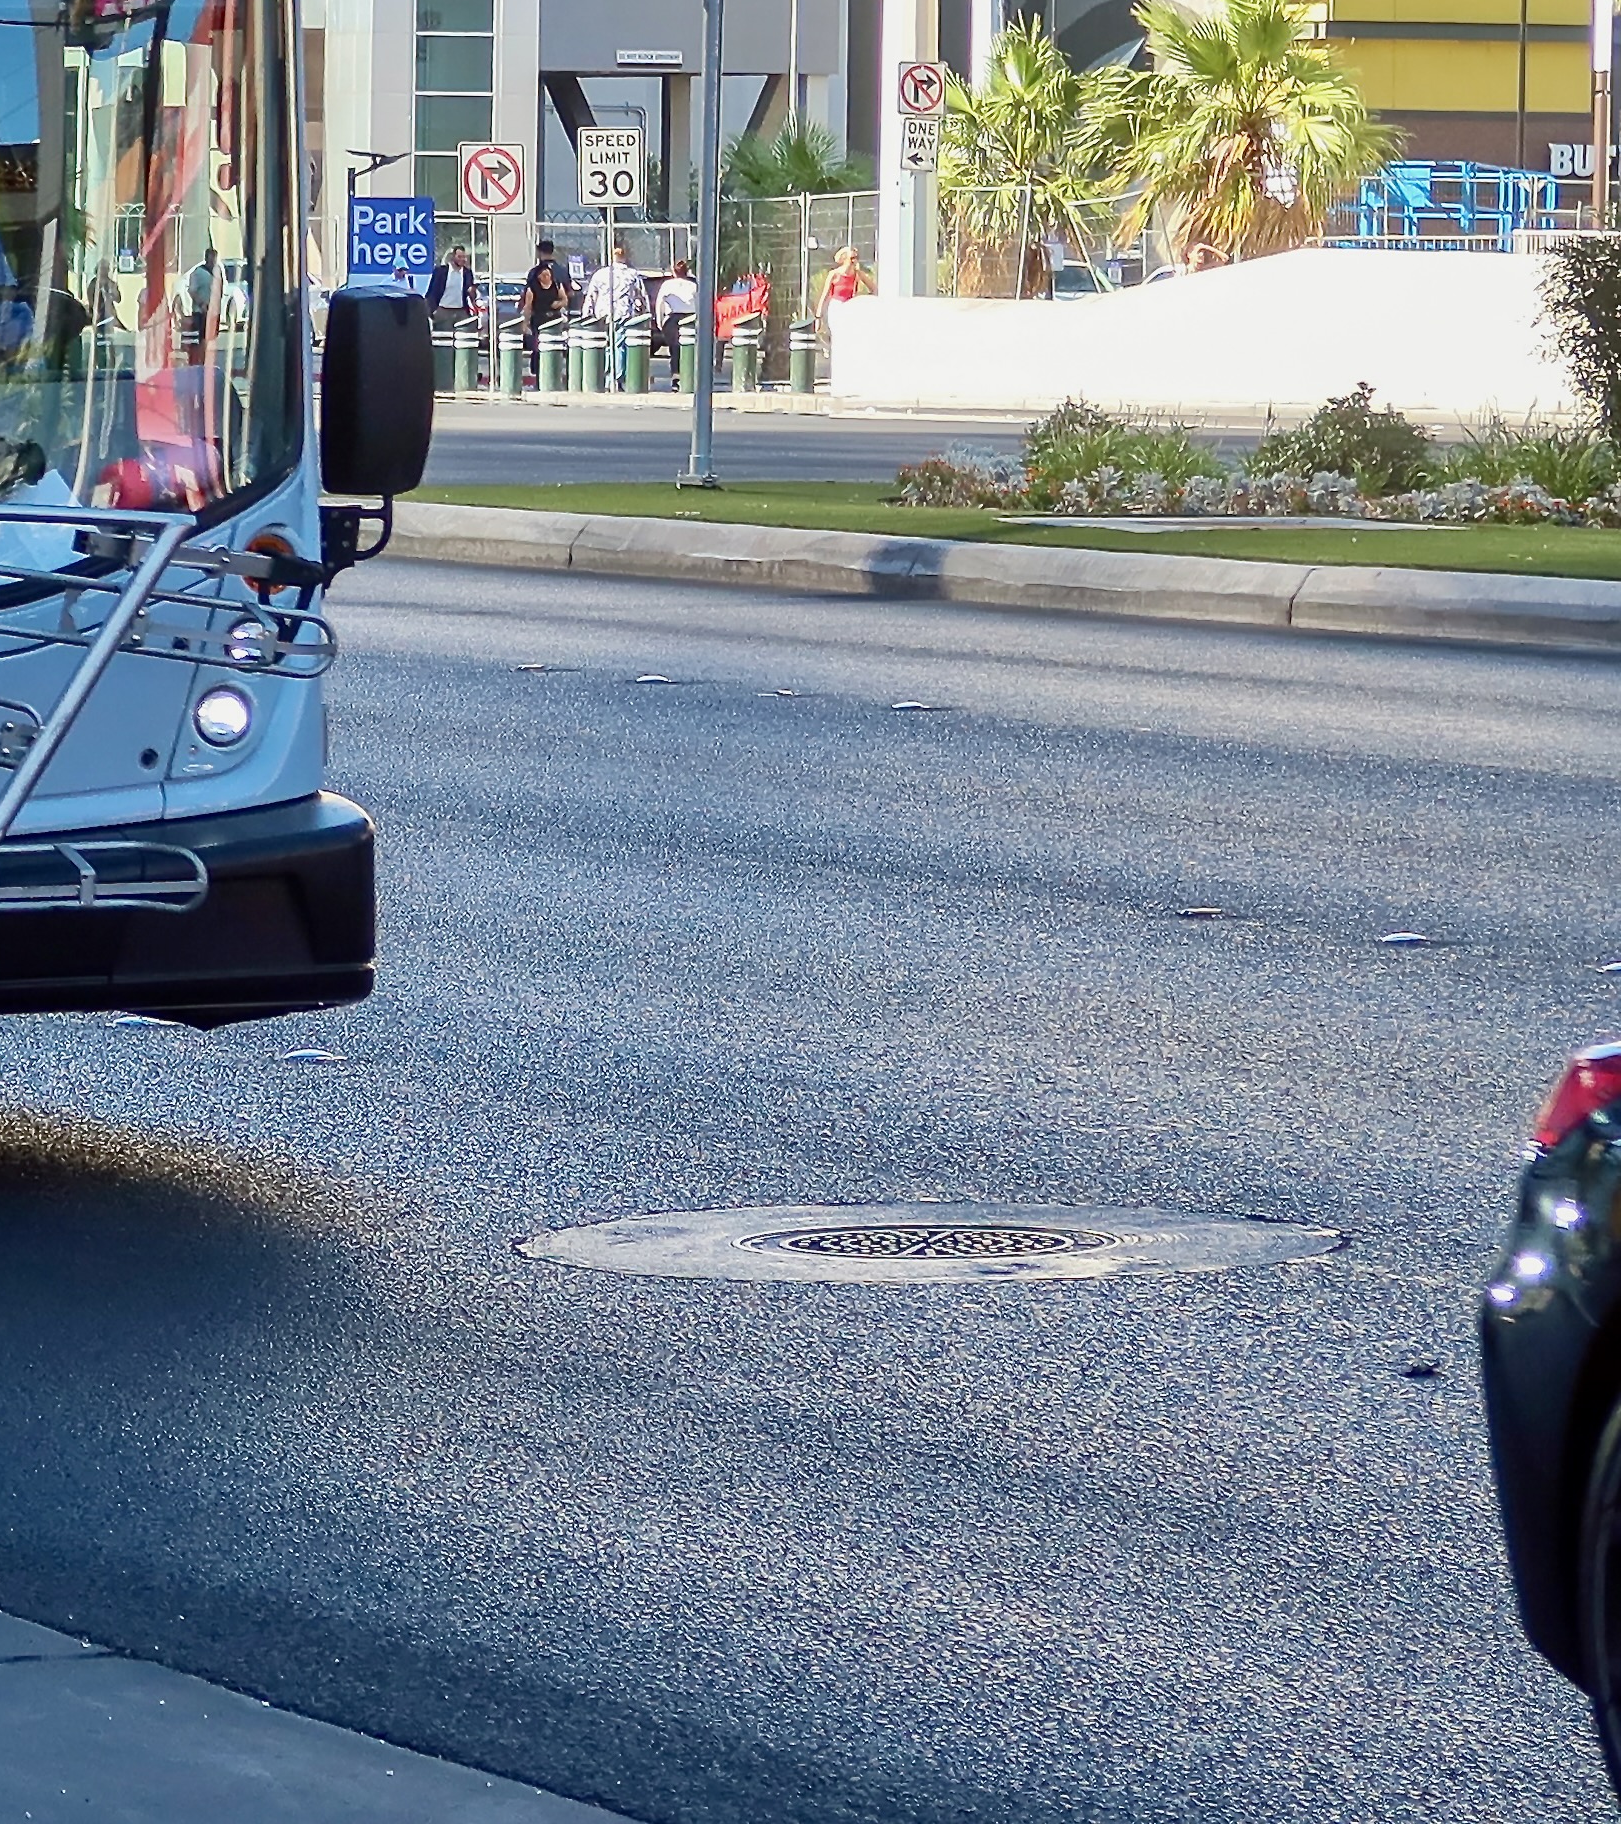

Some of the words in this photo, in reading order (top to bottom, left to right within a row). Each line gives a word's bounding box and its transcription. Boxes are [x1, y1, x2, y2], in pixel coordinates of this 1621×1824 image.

[908, 121, 936, 136] ONE
[585, 134, 636, 147] SPEED
[908, 136, 936, 150] WAY
[589, 151, 630, 165] LIMIT
[588, 170, 634, 198] 30
[353, 205, 427, 235] Park
[352, 235, 428, 265] here
